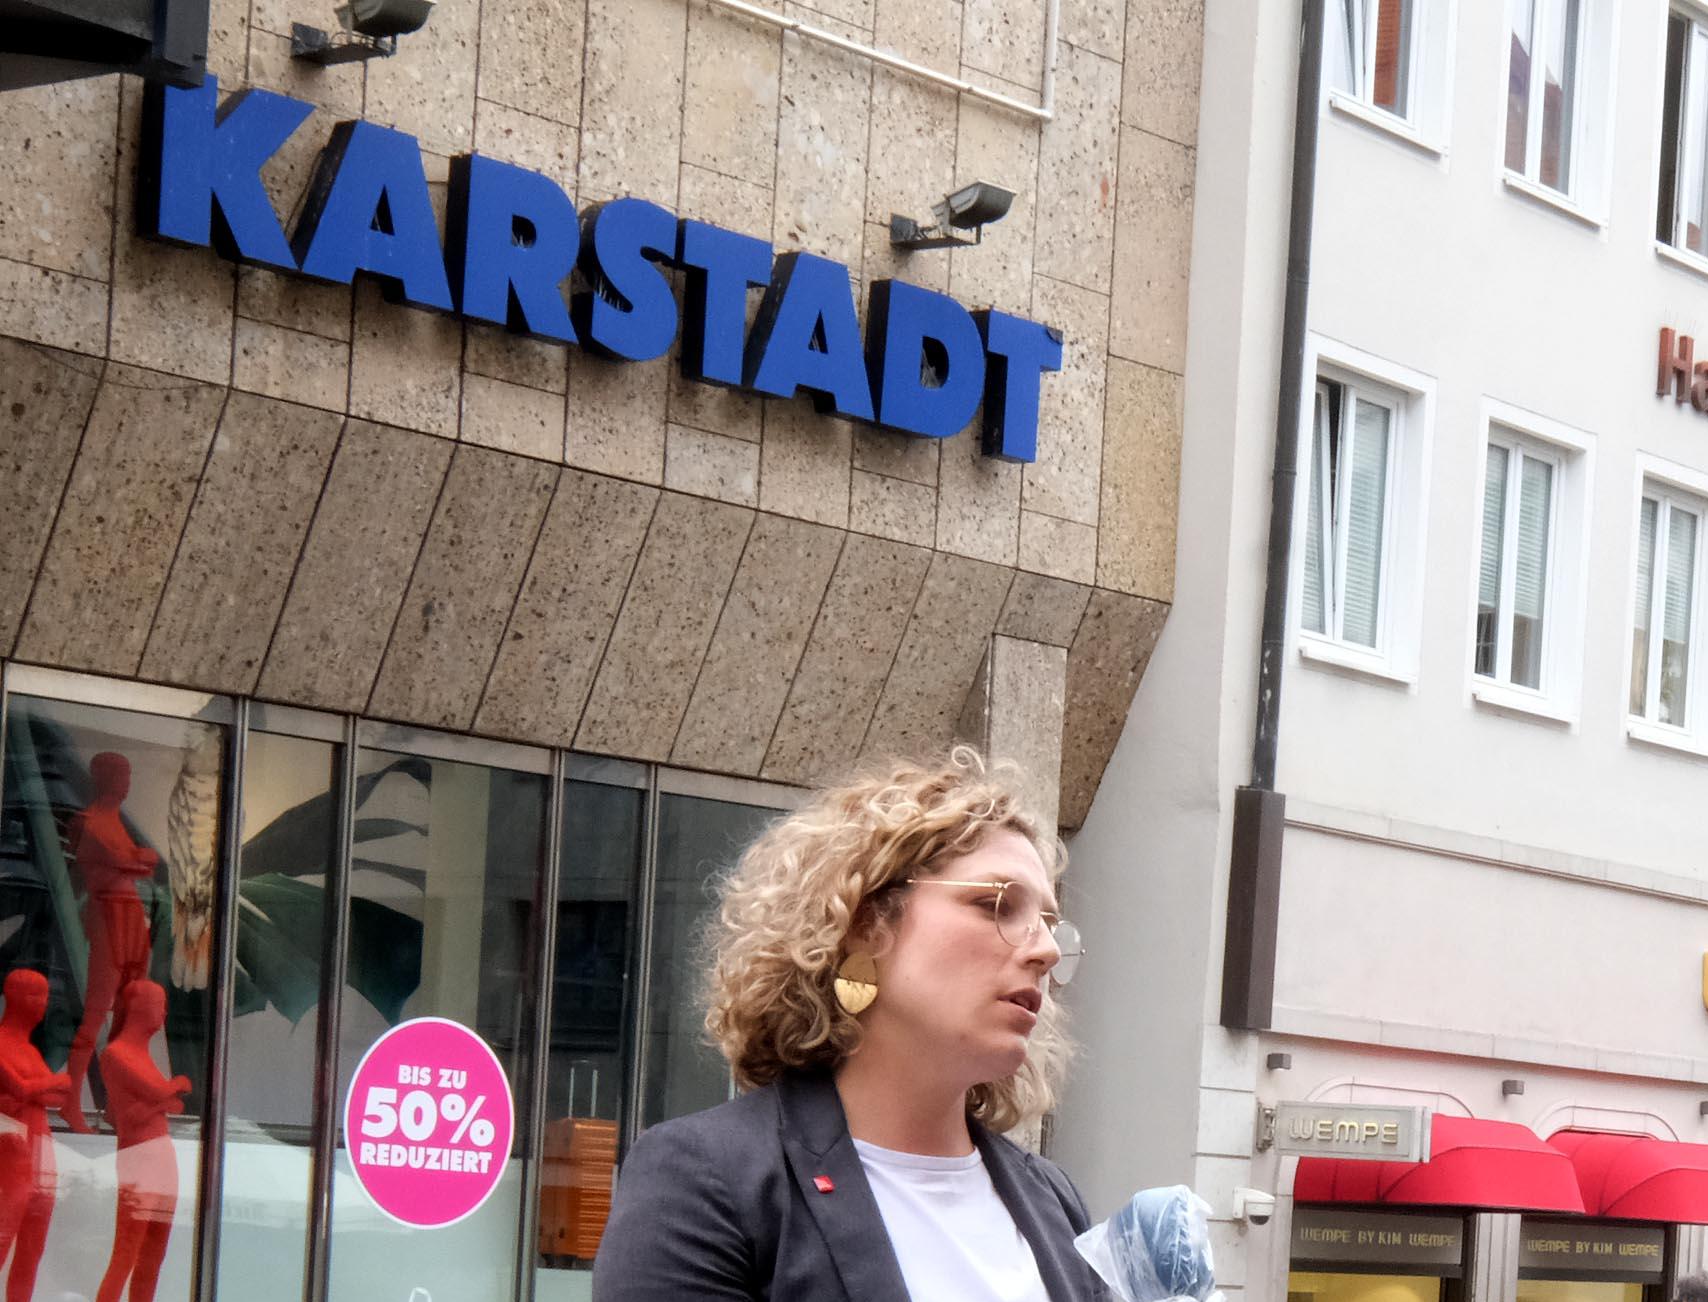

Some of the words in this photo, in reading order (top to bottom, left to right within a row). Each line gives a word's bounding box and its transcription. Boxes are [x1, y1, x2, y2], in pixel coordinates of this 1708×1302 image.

[142, 74, 1063, 463] KARSTADT
[397, 1064, 432, 1087] BIS
[437, 1068, 468, 1090] ZU
[361, 1086, 496, 1147] 50%
[1289, 1115, 1399, 1144] WEMPE
[359, 1142, 493, 1174] REDUZIERT
[1300, 1227, 1351, 1244] WEMPE
[1409, 1233, 1458, 1248] WEMPE
[1527, 1239, 1570, 1253] WEMPE
[1575, 1241, 1591, 1254] BY
[1618, 1243, 1659, 1257] WEMPE
